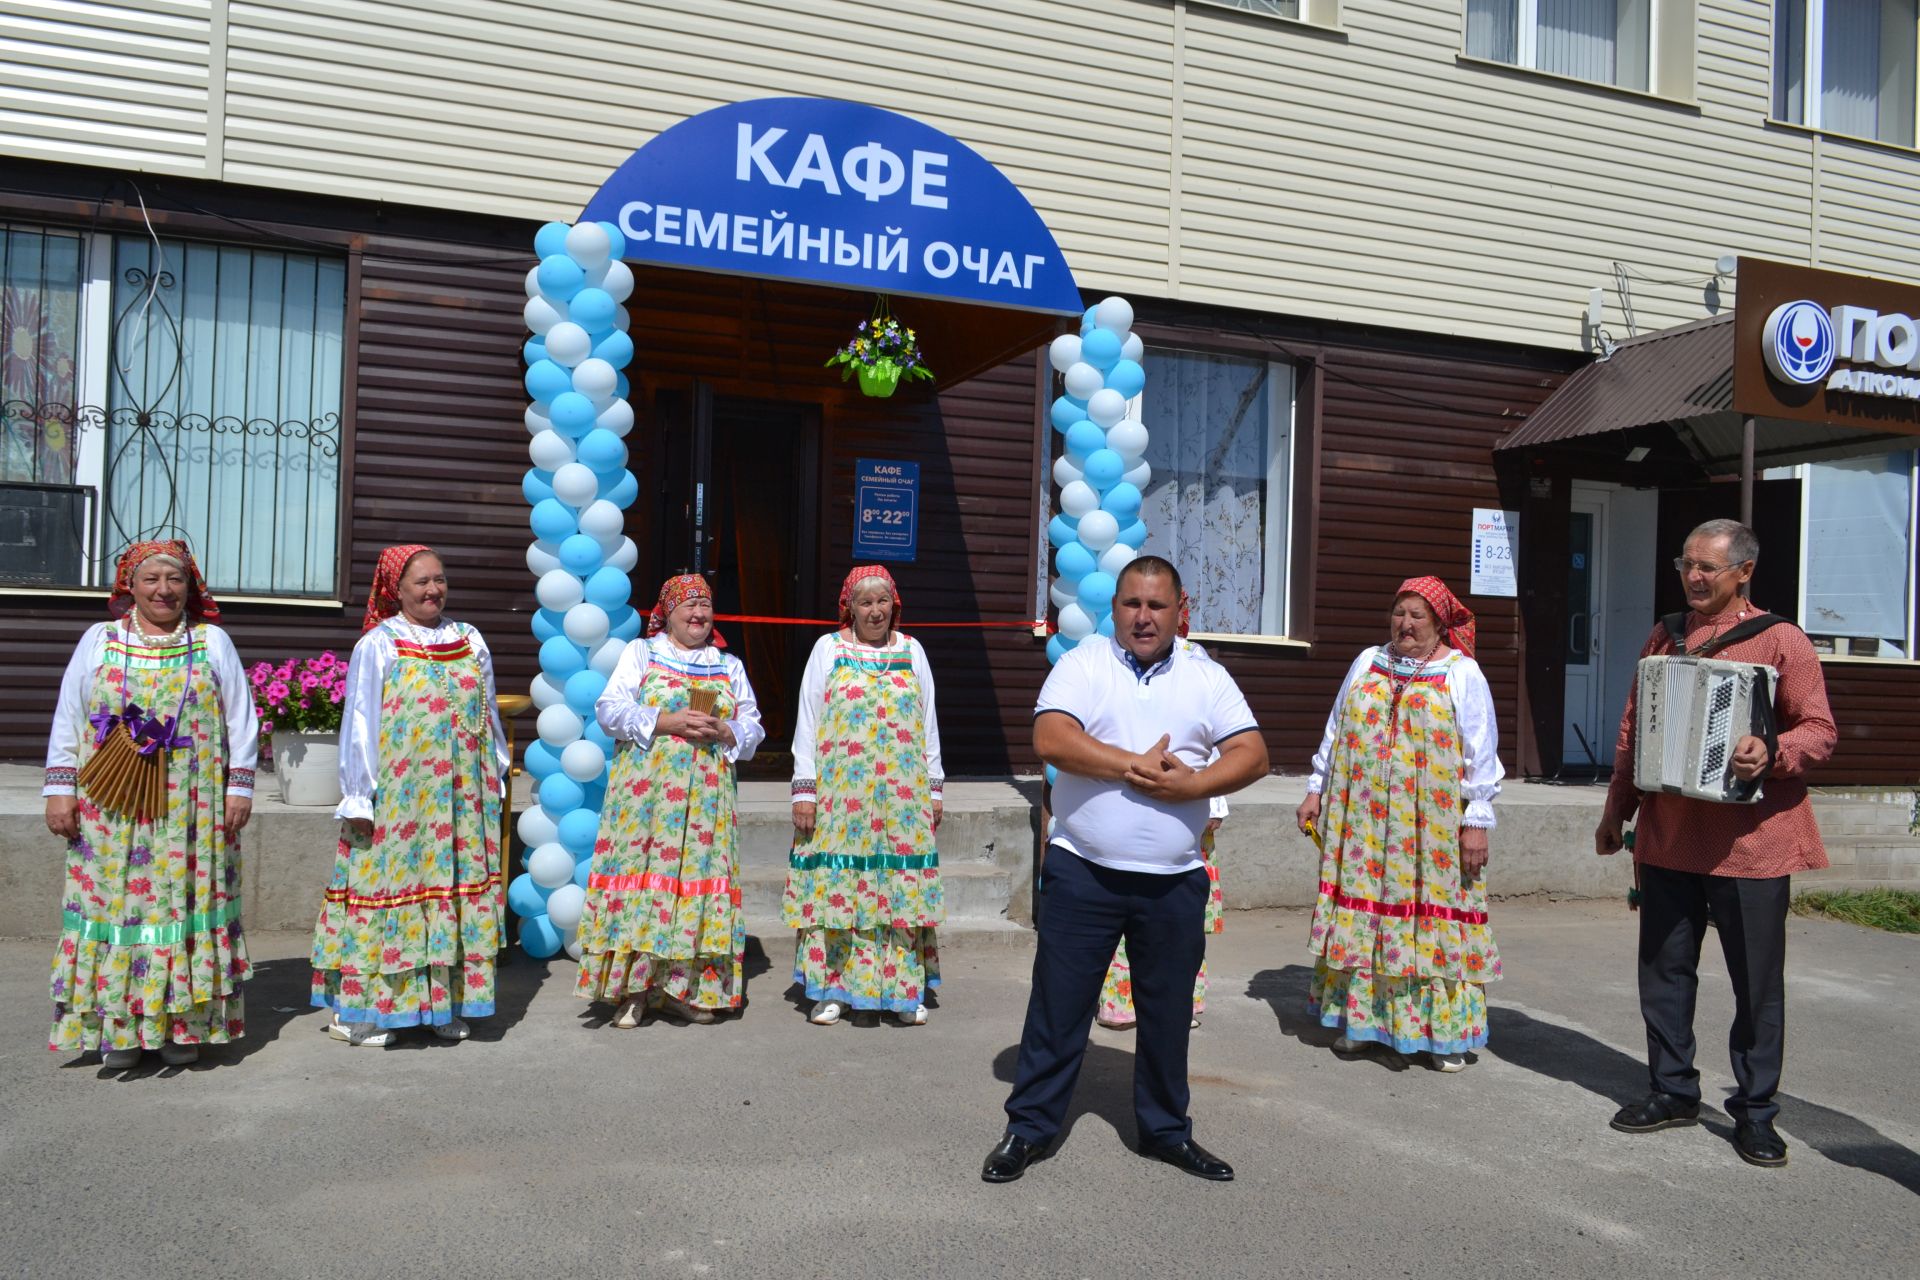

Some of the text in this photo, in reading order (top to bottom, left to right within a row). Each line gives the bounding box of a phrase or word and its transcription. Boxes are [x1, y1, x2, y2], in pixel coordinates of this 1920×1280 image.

[735, 122, 949, 210] КАФЕ
[617, 200, 1046, 290] СЕМЕЙНЫЙ ОЧАГ
[1831, 304, 1920, 371] ПО
[1826, 368, 1920, 399] АЛКОМ
[861, 475, 897, 484] СЕМЕЙНЫЙ
[874, 465, 902, 475] КАФЕ
[1486, 545, 1512, 560] 8-23
